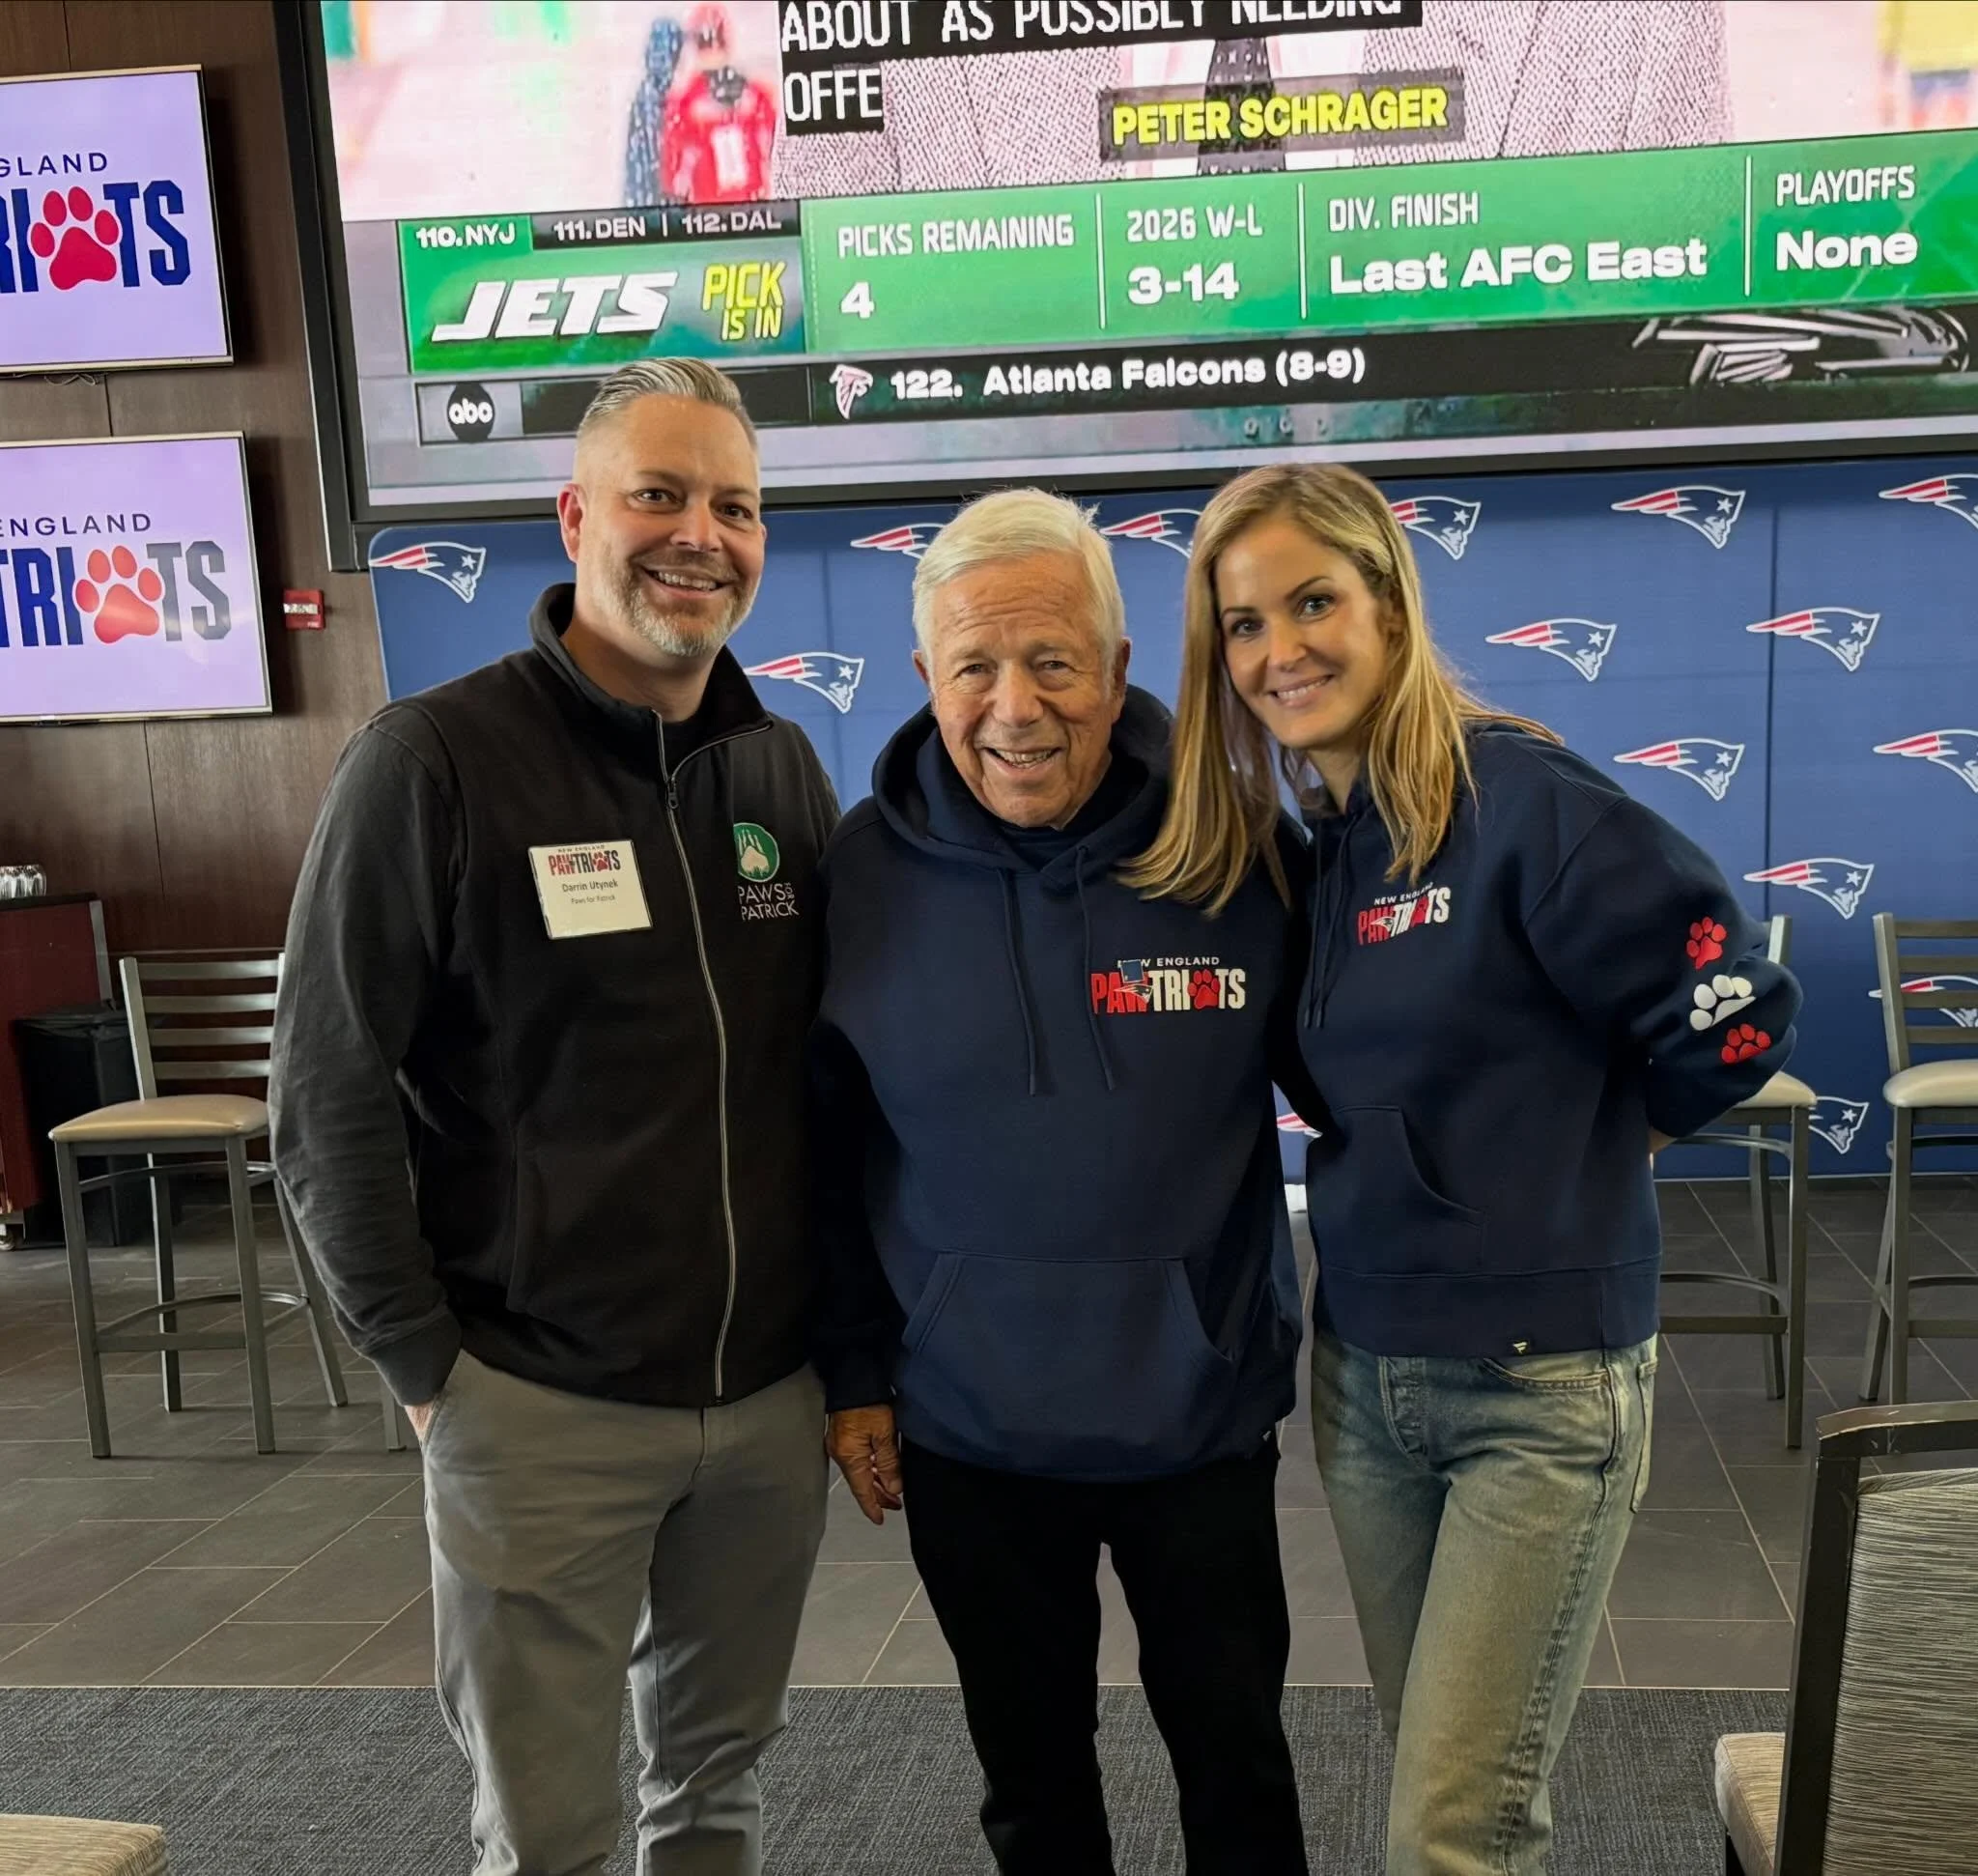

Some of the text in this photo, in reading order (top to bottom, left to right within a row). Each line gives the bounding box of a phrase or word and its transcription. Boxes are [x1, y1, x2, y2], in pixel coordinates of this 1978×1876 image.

[781, 0, 913, 51] ABOUT
[941, 0, 994, 43] AS
[783, 69, 883, 122] OFFE
[1113, 87, 1448, 146] PETER SCHRAGER
[1776, 164, 1916, 206] PLAYOFFS
[1126, 203, 1263, 242] 2026 W-L
[1329, 191, 1479, 232] DIV. FINISH
[837, 213, 1075, 259] PICKS REMAINING
[1776, 230, 1919, 271] None
[702, 260, 787, 312] PICK
[1126, 262, 1240, 305] 3-14
[1329, 238, 1708, 295] Last AFC East
[431, 271, 679, 343] JETS
[839, 281, 875, 320] 4
[721, 305, 783, 341] IS IN
[890, 347, 1366, 400] 122. Atlanta Falcons (8-9)
[737, 882, 786, 905] PAWS
[741, 899, 800, 921] PATRICK
[1373, 895, 1398, 906] NEW
[1156, 956, 1220, 967] ENGLAND
